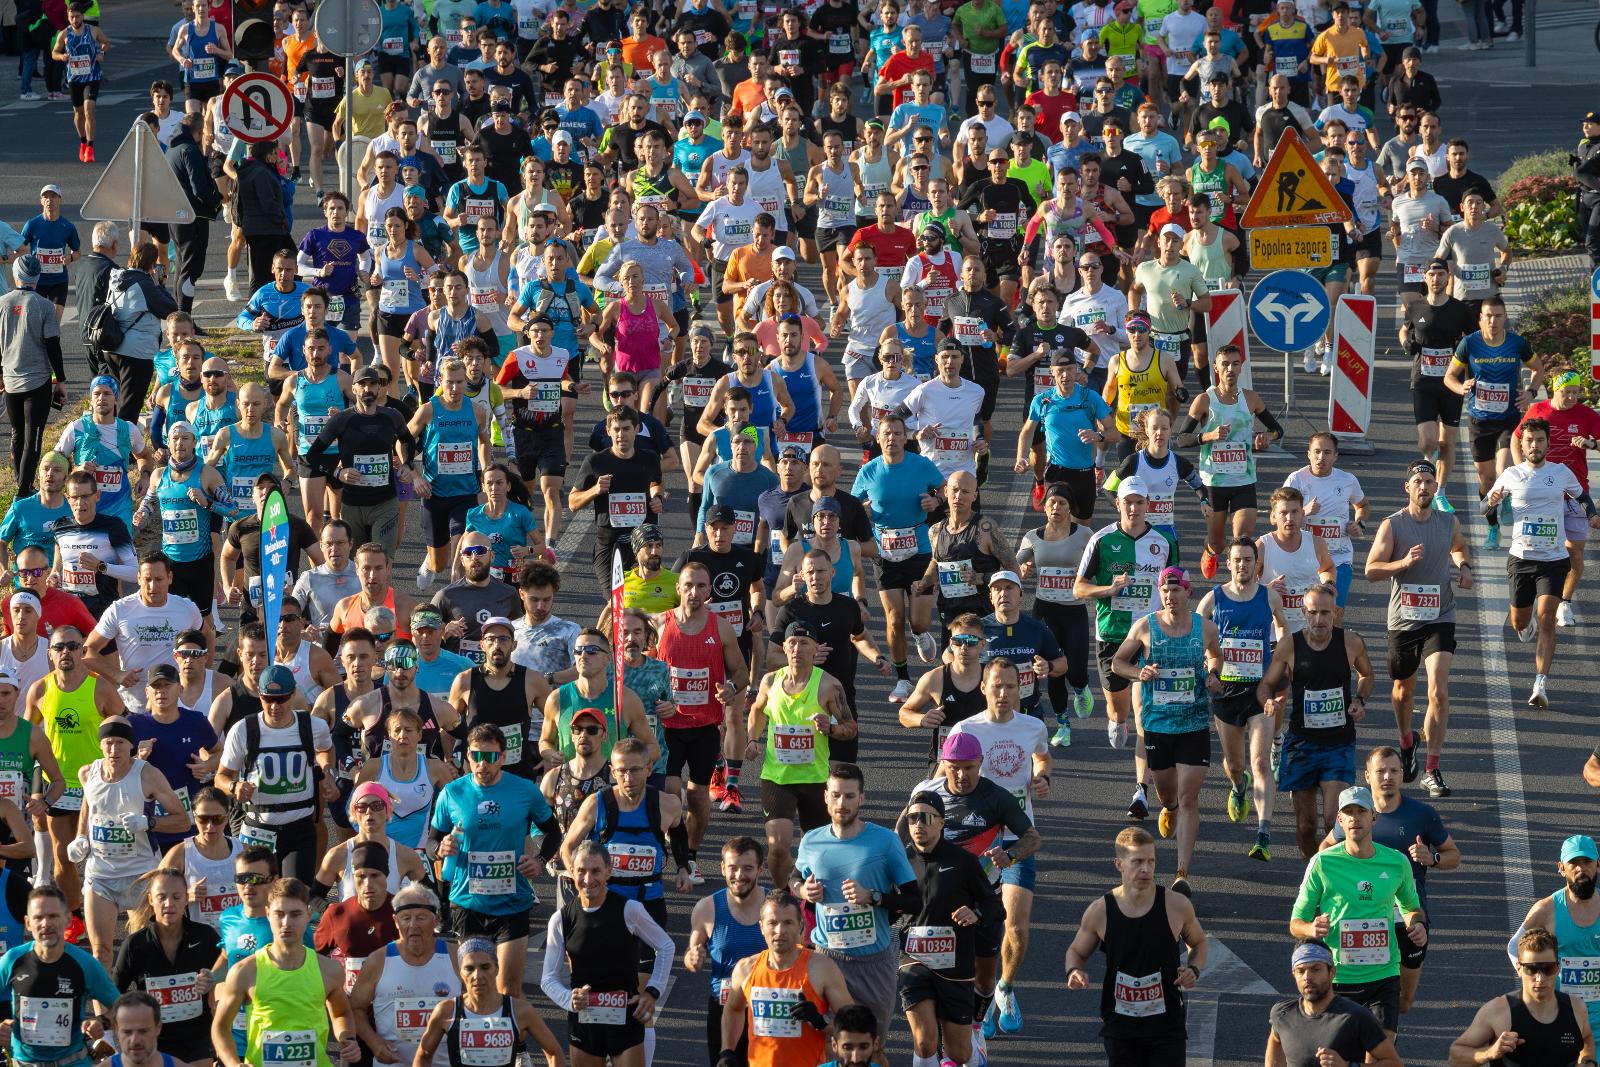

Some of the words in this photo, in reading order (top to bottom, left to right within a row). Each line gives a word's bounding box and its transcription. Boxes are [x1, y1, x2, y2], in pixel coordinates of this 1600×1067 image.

[468, 207, 474, 216] A
[475, 207, 493, 216] 11839
[911, 202, 931, 210] GOWE
[999, 220, 1015, 228] 1085
[1254, 239, 1292, 260] Popolna
[1295, 242, 1327, 258] zapora
[48, 256, 60, 264] 637
[398, 289, 406, 297] 42
[934, 298, 945, 307] 120
[1081, 316, 1086, 325] A
[963, 326, 978, 335] 1150
[1162, 342, 1169, 350] A
[1170, 342, 1180, 351] 33
[1130, 374, 1149, 383] MATT
[542, 391, 559, 400] 1382
[686, 386, 692, 395] A
[310, 426, 316, 435] B
[939, 441, 945, 450] A
[950, 440, 968, 450] 8700
[443, 453, 448, 462] A
[454, 452, 471, 462] 8892
[1216, 452, 1222, 462] A
[1222, 451, 1245, 462] 11761
[368, 464, 388, 474] 3436
[103, 472, 120, 484] 6710
[238, 488, 244, 497] A
[614, 503, 620, 513] A
[626, 503, 644, 513] 9513
[1155, 502, 1172, 512] 4498
[168, 521, 173, 531] A
[175, 520, 197, 530] 3330
[736, 522, 752, 532] 609
[1527, 526, 1533, 535] A
[1536, 526, 1556, 535] 2580
[1320, 527, 1339, 537] 7874
[265, 538, 287, 554] Heineken
[885, 540, 892, 550] A
[892, 536, 915, 549] 12363
[71, 574, 93, 584] 11503
[1043, 576, 1050, 588] A
[1051, 576, 1075, 588] 11416
[1122, 587, 1129, 596] A
[1132, 586, 1148, 597] 343
[1286, 596, 1303, 607] 1160
[1405, 595, 1412, 605] A
[1418, 595, 1438, 607] 7321
[474, 652, 485, 663] 33
[1229, 651, 1236, 662] A
[1236, 651, 1261, 662] 11634
[673, 680, 679, 691] A
[686, 680, 707, 691] 6467
[1160, 681, 1166, 690] B
[1174, 681, 1190, 691] 121
[1311, 703, 1317, 712] B
[1320, 701, 1342, 713] 2072
[776, 738, 782, 748] A
[790, 738, 812, 748] 6451
[0, 785, 16, 796] 258
[97, 826, 103, 841] A
[612, 854, 620, 867] B
[628, 856, 653, 870] 6346
[476, 867, 484, 878] A
[486, 863, 513, 878] 2732
[205, 896, 213, 912] A
[221, 895, 242, 911] 687
[832, 917, 840, 929] C
[844, 915, 871, 929] 2185
[911, 940, 920, 952] A
[922, 938, 953, 952] 10394
[1346, 934, 1355, 947] B
[1362, 933, 1387, 947] 8853
[1569, 971, 1577, 983] A
[155, 991, 163, 1005] B
[172, 985, 198, 1003] 8865
[598, 993, 624, 1006] 9966
[1121, 988, 1127, 1000] A
[1129, 988, 1160, 1000] 12189
[758, 1002, 766, 1017] B
[769, 1002, 789, 1017] 133
[56, 1014, 69, 1028] 46
[402, 1012, 410, 1027] B
[419, 1012, 431, 1027] 70
[467, 1031, 475, 1047] A
[485, 1030, 511, 1047] 9688
[276, 1046, 284, 1060] A
[287, 1045, 310, 1060] 223
